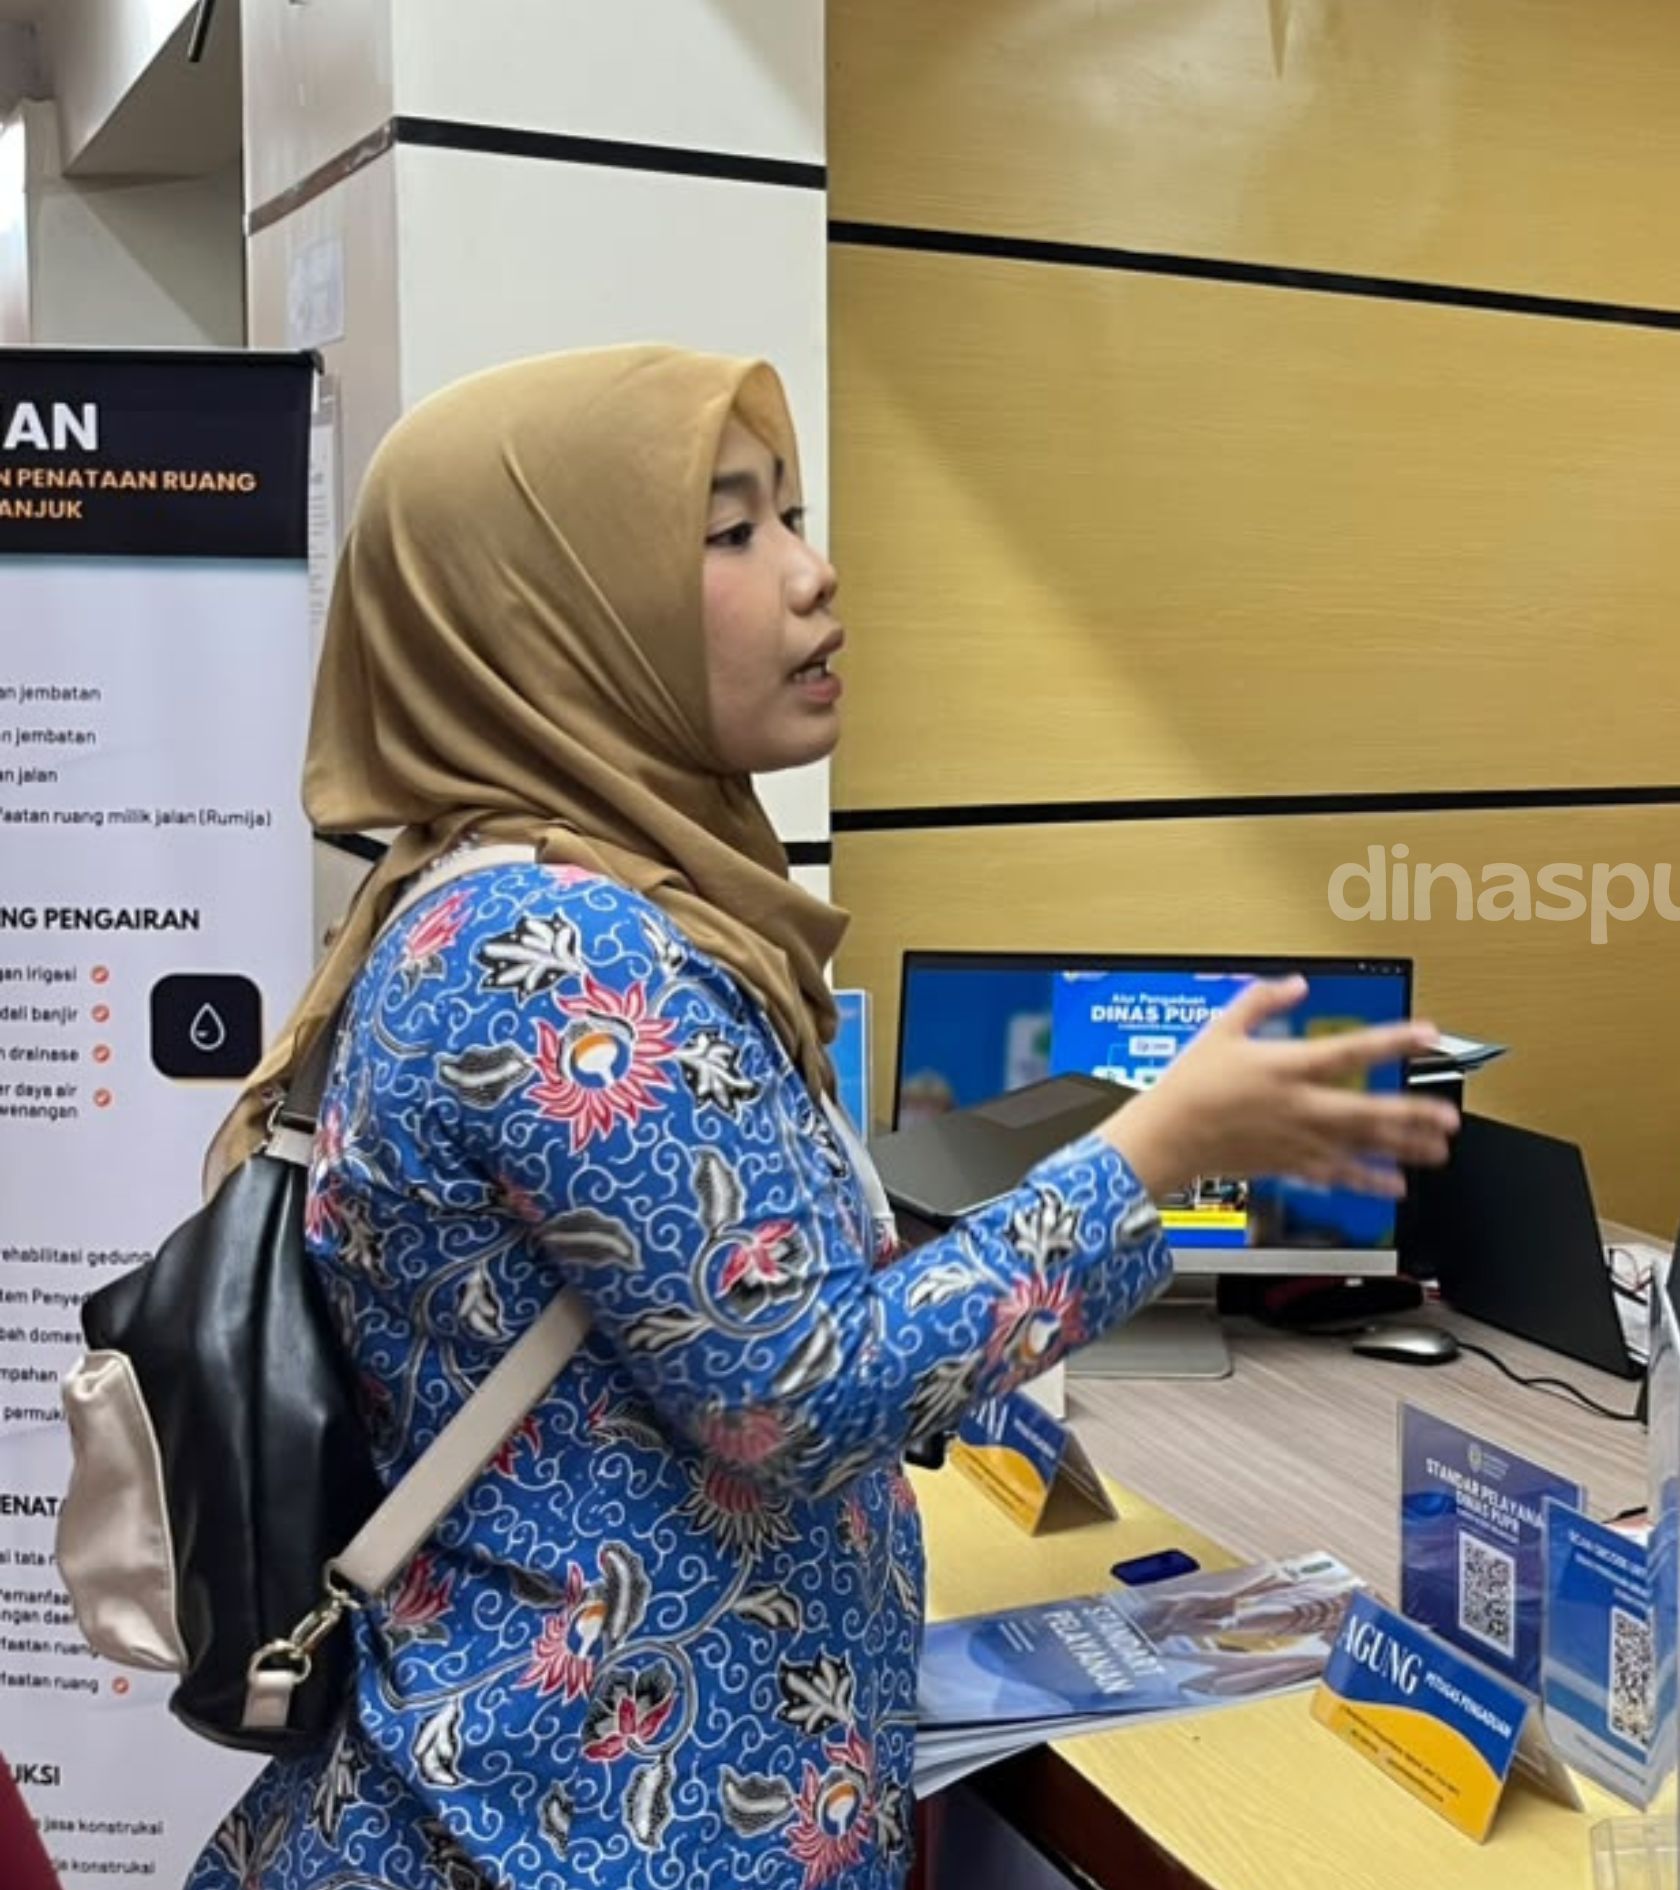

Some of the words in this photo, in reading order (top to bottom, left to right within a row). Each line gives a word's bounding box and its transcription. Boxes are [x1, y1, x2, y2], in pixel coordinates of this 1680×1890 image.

[2, 402, 98, 450] AN
[16, 468, 157, 489] PENATAAN
[163, 471, 257, 491] RUANG
[0, 500, 82, 519] ANJUK
[19, 683, 101, 704] jembatan
[15, 726, 96, 747] jembatan
[18, 766, 58, 786] jalan
[54, 810, 104, 827] ruang
[107, 808, 151, 824] milik
[154, 808, 196, 826] jalan
[198, 809, 272, 829] (Rumija)
[44, 908, 200, 931] PENGAIRAN
[26, 966, 77, 984] irigasi
[31, 1006, 78, 1026] banjir
[1090, 1005, 1160, 1023] DINAS
[9, 1046, 79, 1062] drainase
[15, 1082, 53, 1099] daya
[56, 1084, 77, 1097] air
[1, 1495, 58, 1516] ENAT
[15, 1552, 45, 1565] tata
[1041, 1609, 1137, 1695] PELAYANAN
[1336, 1614, 1423, 1696] AGUNG
[54, 1676, 99, 1693] ruang
[78, 1818, 164, 1835] konstruksi
[71, 1859, 156, 1874] konstruksi
